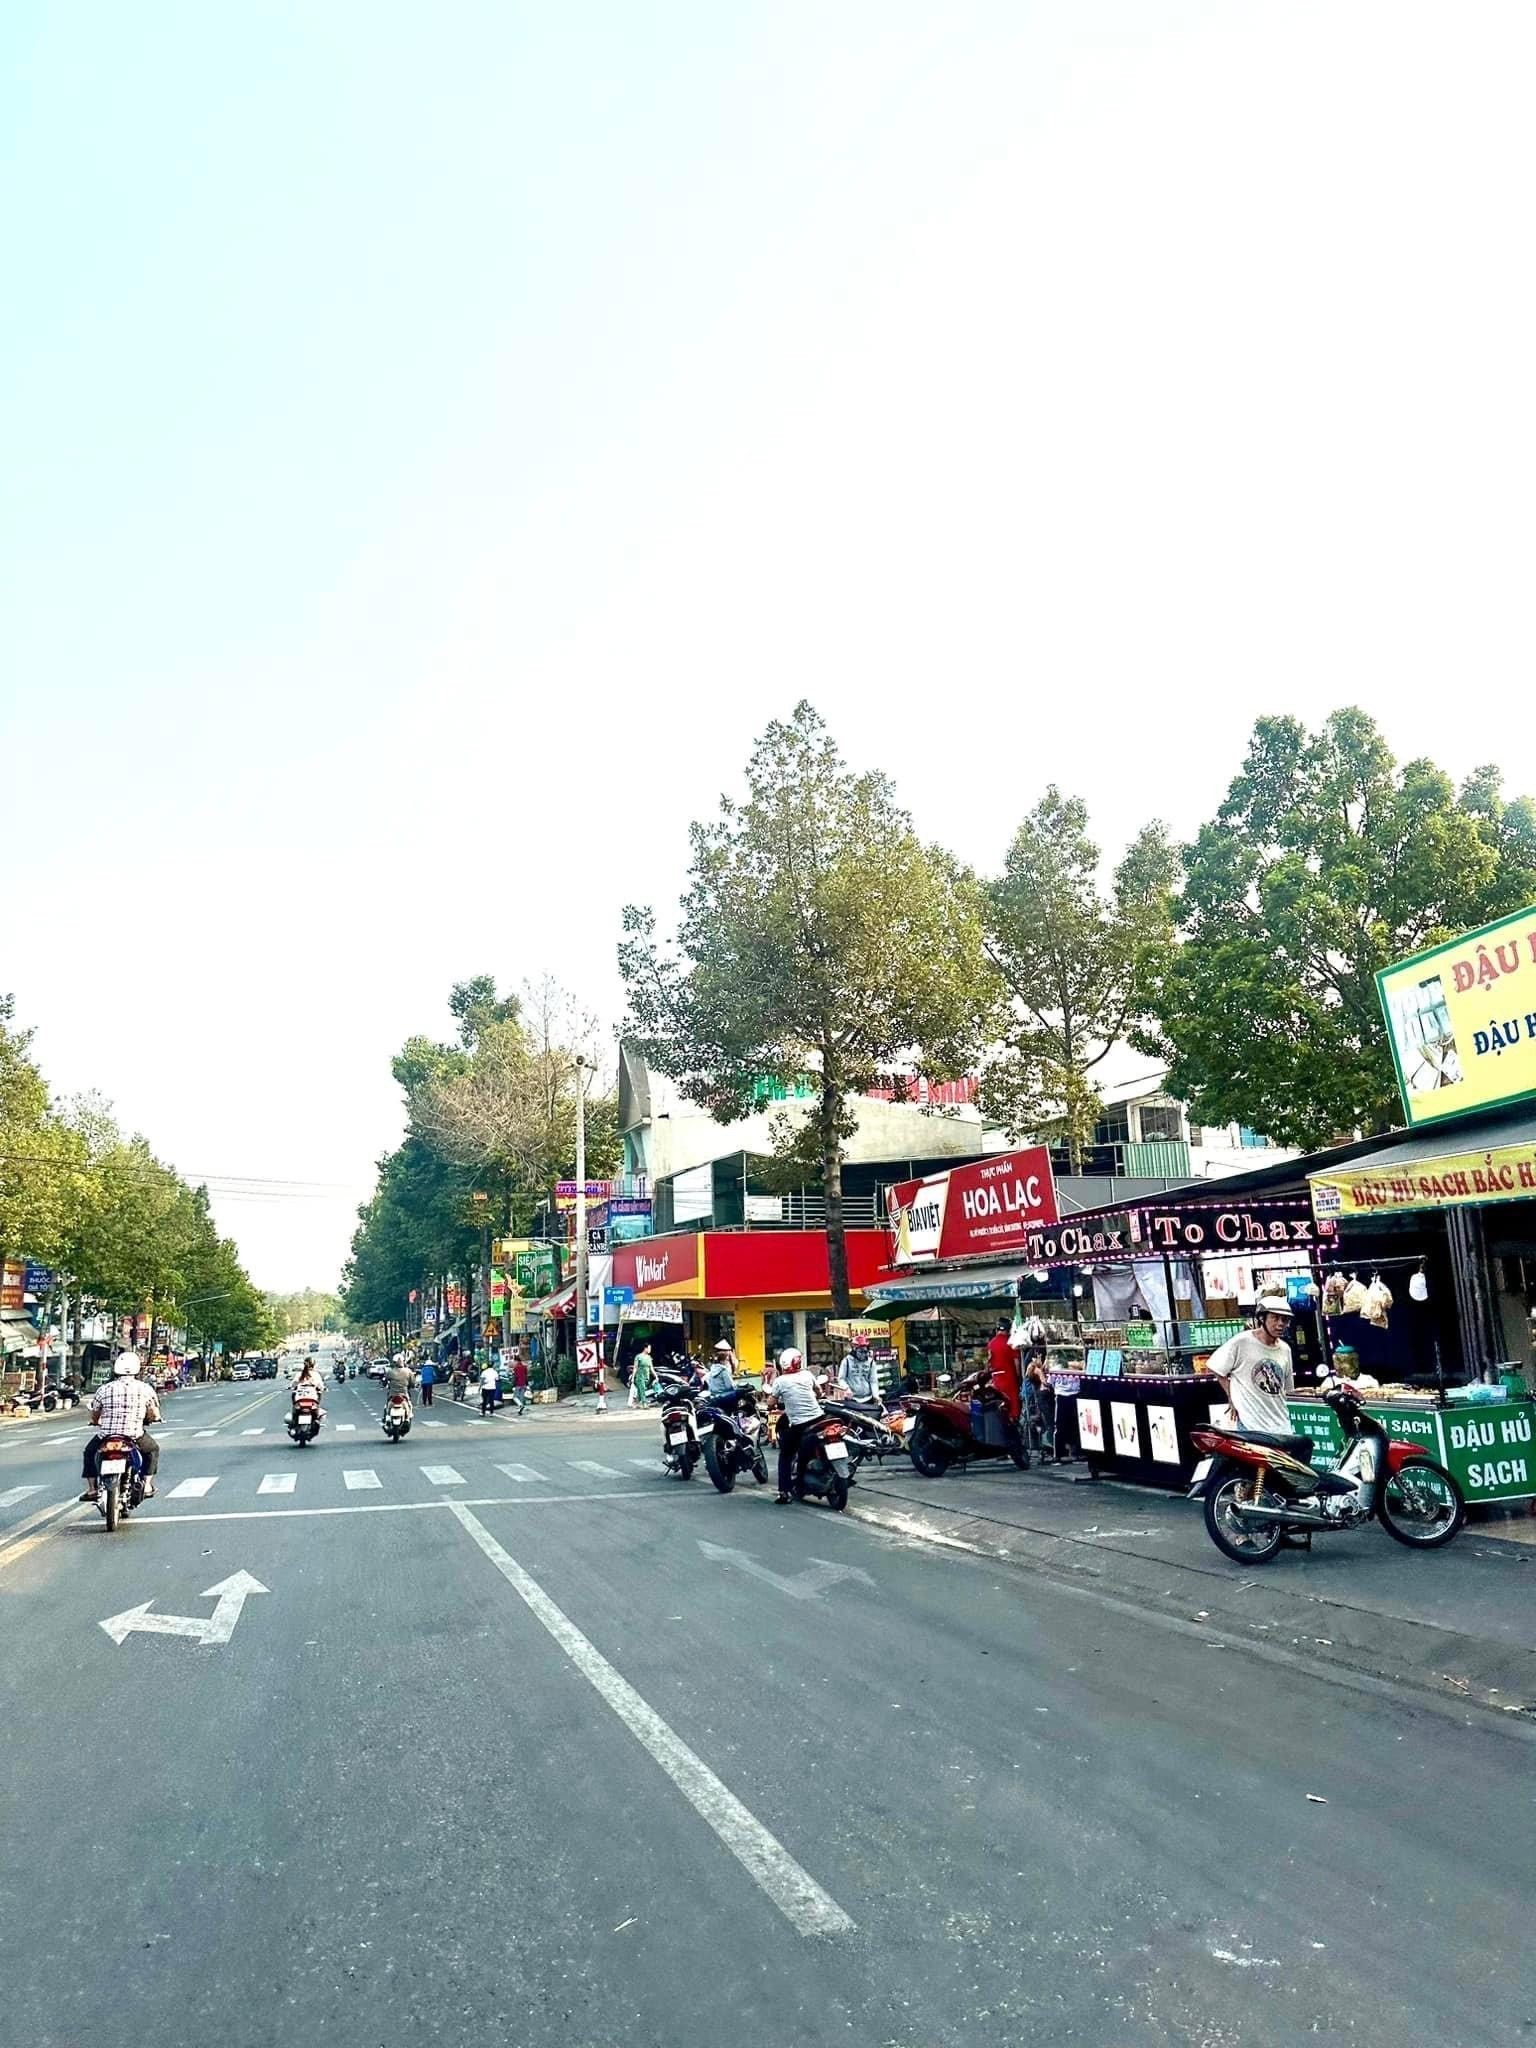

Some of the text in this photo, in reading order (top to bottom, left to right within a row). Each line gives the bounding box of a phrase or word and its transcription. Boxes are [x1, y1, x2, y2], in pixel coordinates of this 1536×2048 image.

[1452, 945, 1519, 993] ĐẬU
[1473, 1020, 1520, 1056] ĐẬU
[962, 1175, 1042, 1219] HOA LẠC
[1419, 1171, 1470, 1205] SẠCH
[1471, 1154, 1514, 1193] BẮC
[1028, 1234, 1056, 1259] To
[1060, 1228, 1124, 1255] Chax
[1154, 1216, 1204, 1246] To
[1215, 1213, 1313, 1242] Chax
[1391, 1419, 1433, 1435] SẠCH
[1450, 1411, 1532, 1452] ĐẬU HỦ
[1467, 1458, 1528, 1491] SẠCH
